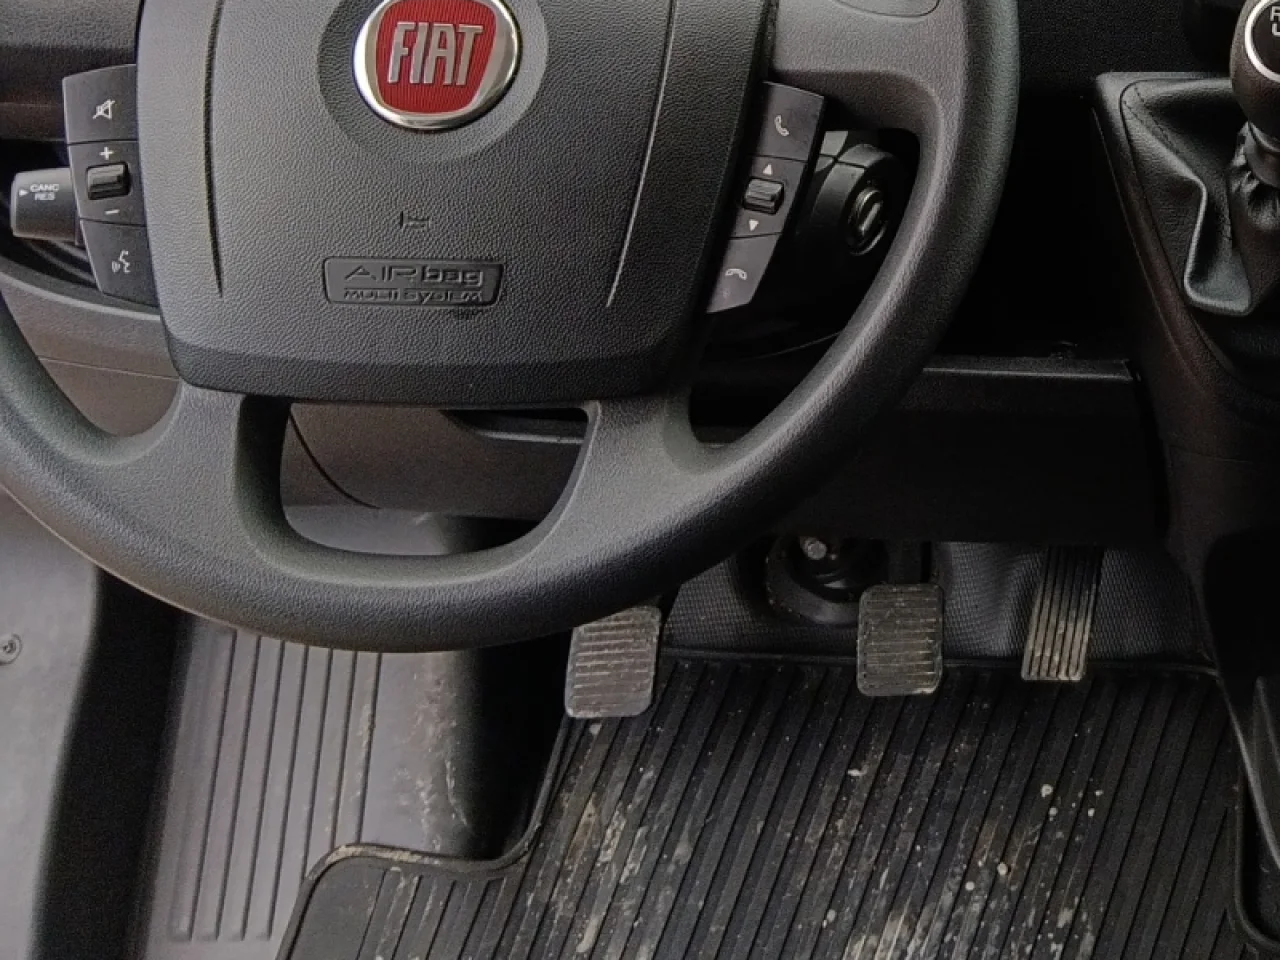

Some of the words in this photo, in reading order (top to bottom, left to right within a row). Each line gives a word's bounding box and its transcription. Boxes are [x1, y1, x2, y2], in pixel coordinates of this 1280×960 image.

[387, 22, 484, 86] FIAT
[30, 183, 59, 192] CANC
[34, 192, 56, 201] RES
